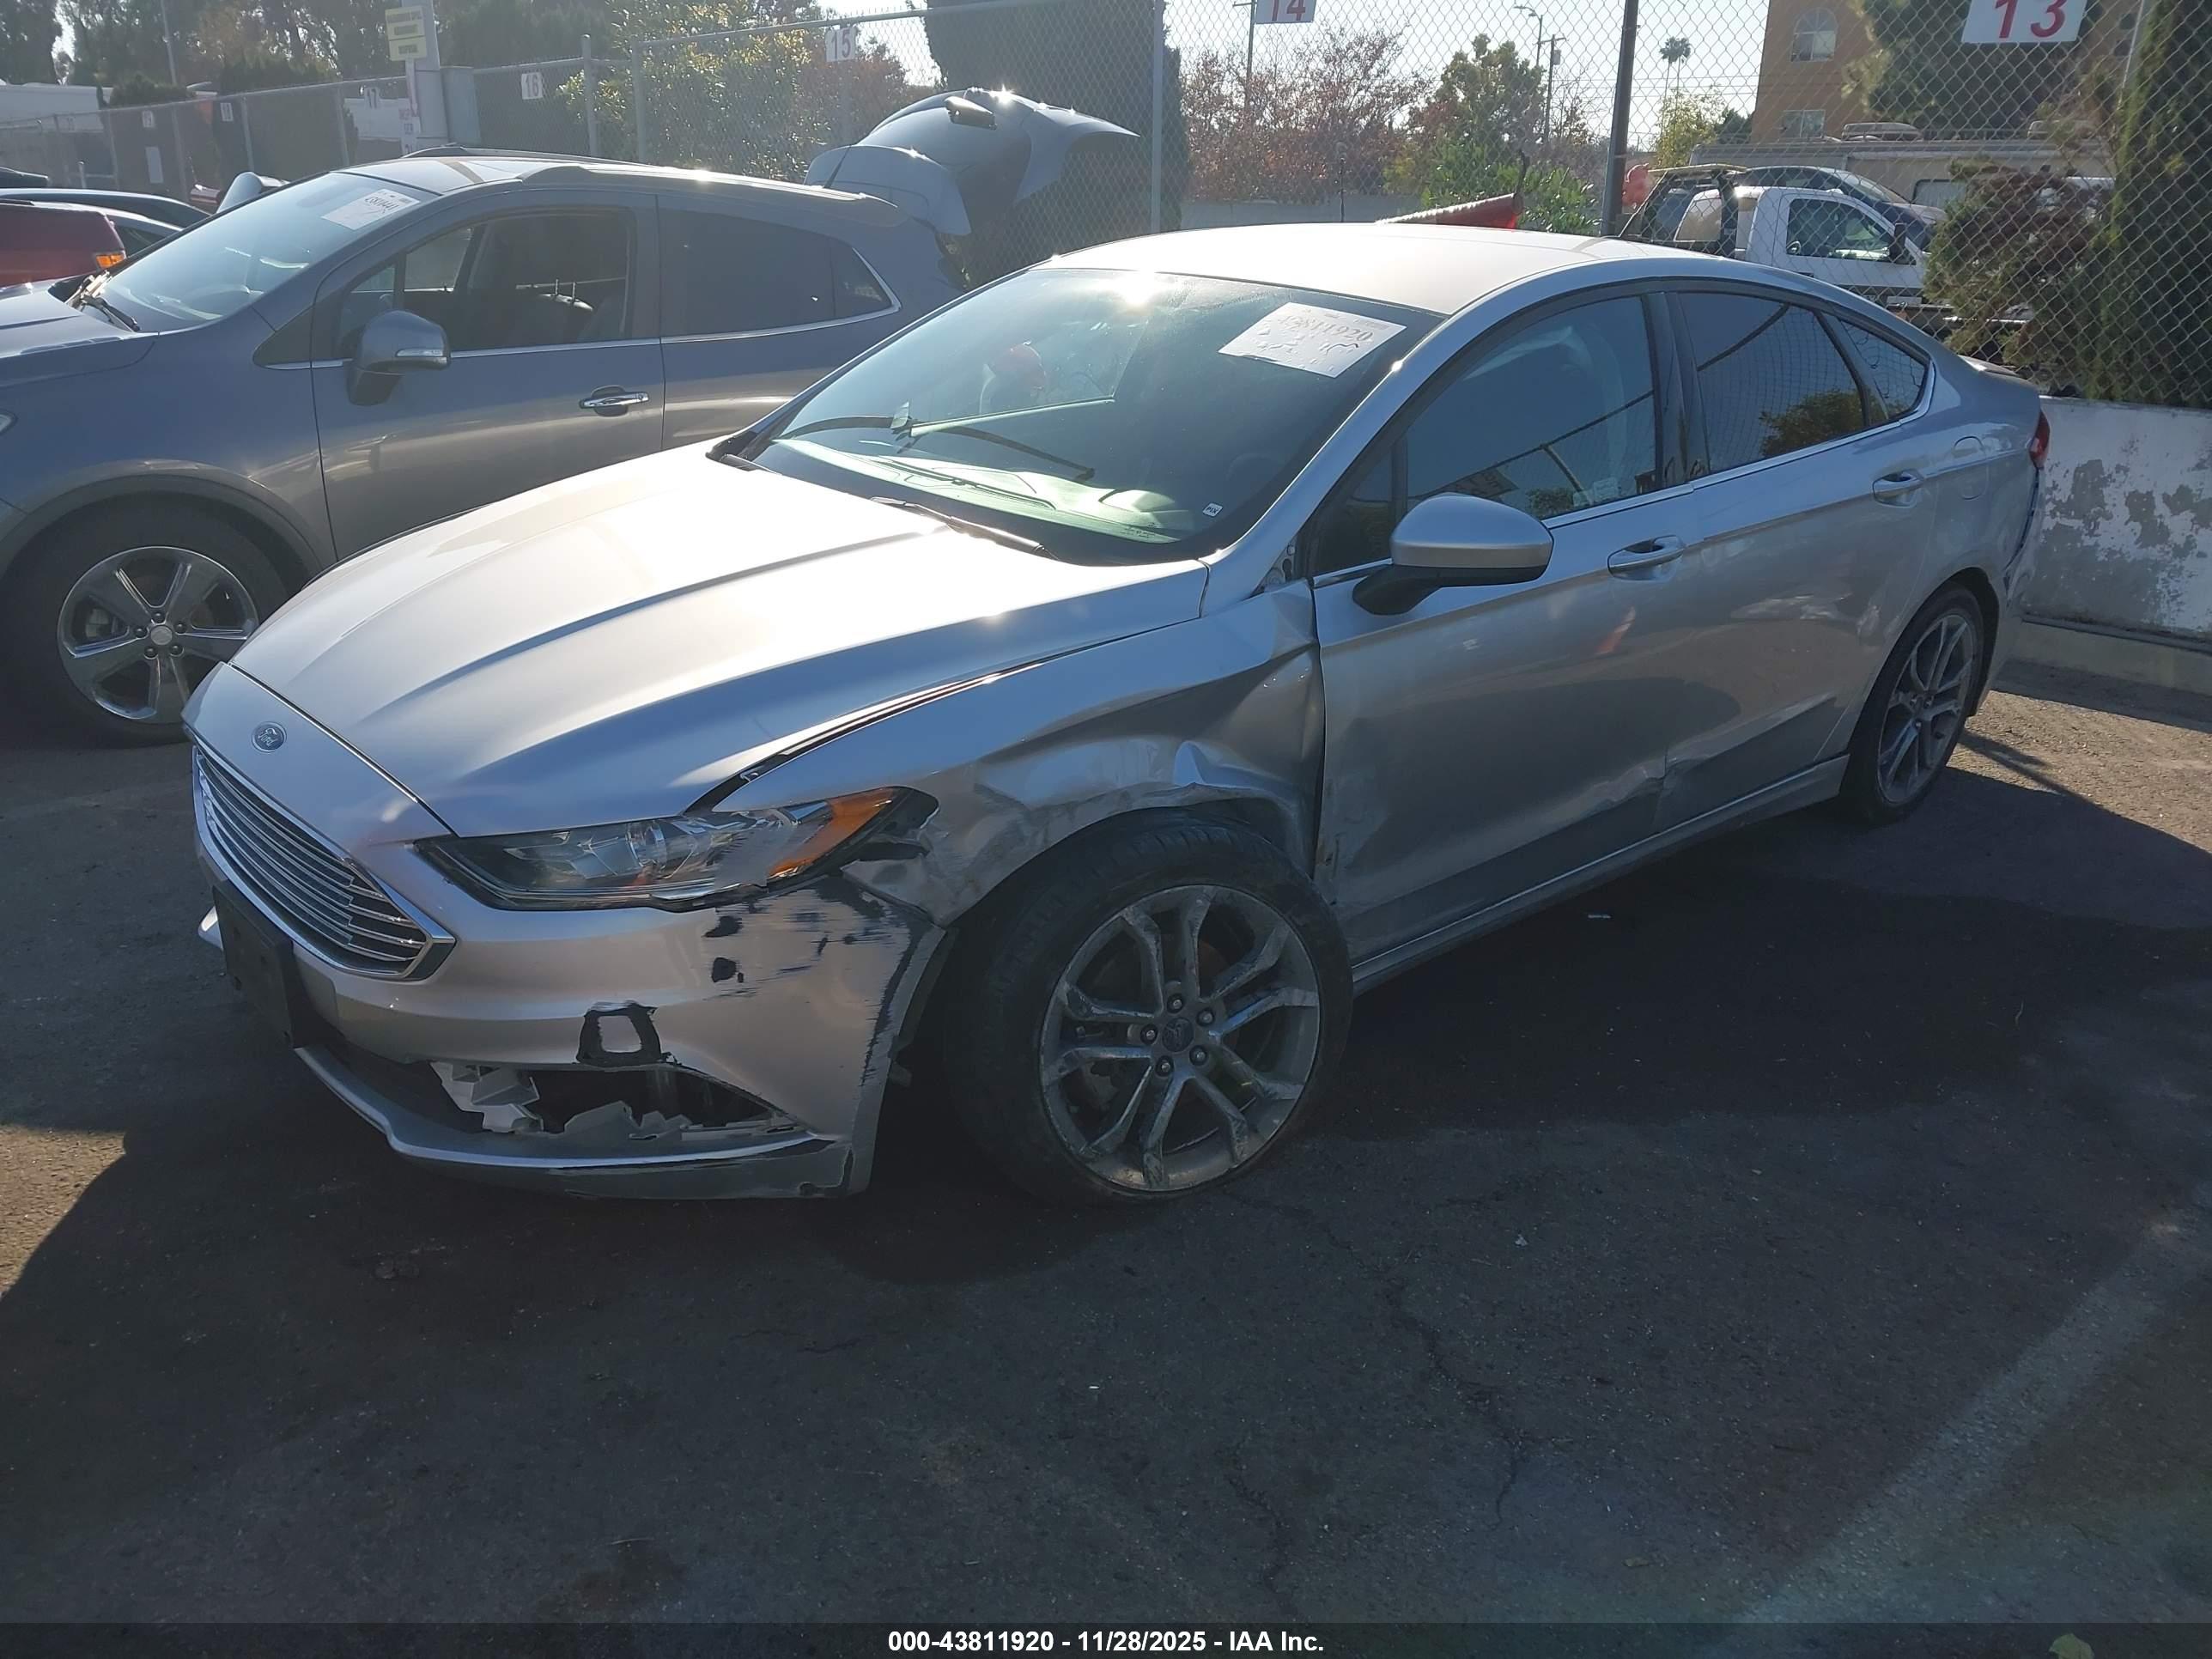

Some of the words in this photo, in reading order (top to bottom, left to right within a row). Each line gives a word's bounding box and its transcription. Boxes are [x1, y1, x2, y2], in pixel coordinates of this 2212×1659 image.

[1273, 0, 1305, 21] 14
[1996, 0, 2066, 38] 13
[831, 28, 851, 59] 15
[525, 74, 539, 97] 16
[366, 88, 378, 109] 17
